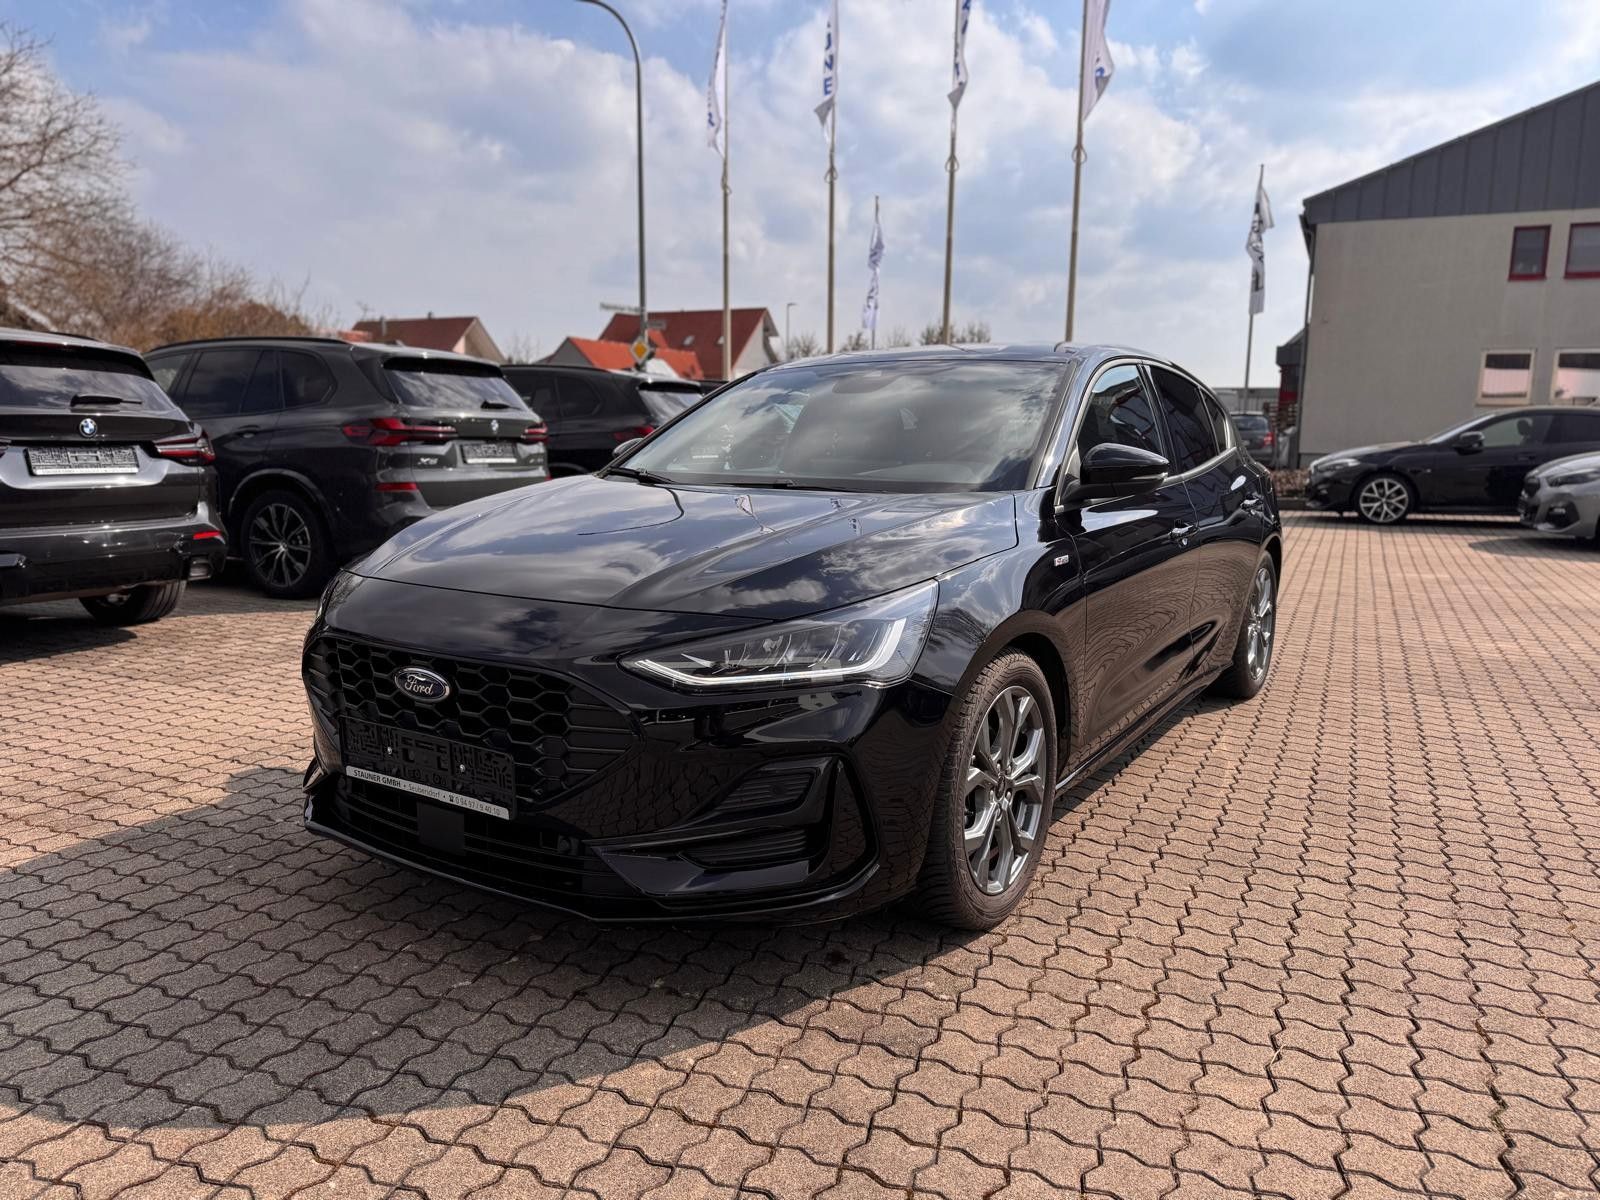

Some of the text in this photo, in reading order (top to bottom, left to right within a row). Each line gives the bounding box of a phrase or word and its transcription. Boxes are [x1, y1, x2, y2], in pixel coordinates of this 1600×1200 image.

[404, 674, 434, 696] Ford
[353, 770, 380, 782] STAUNER
[382, 777, 401, 787] GMBH
